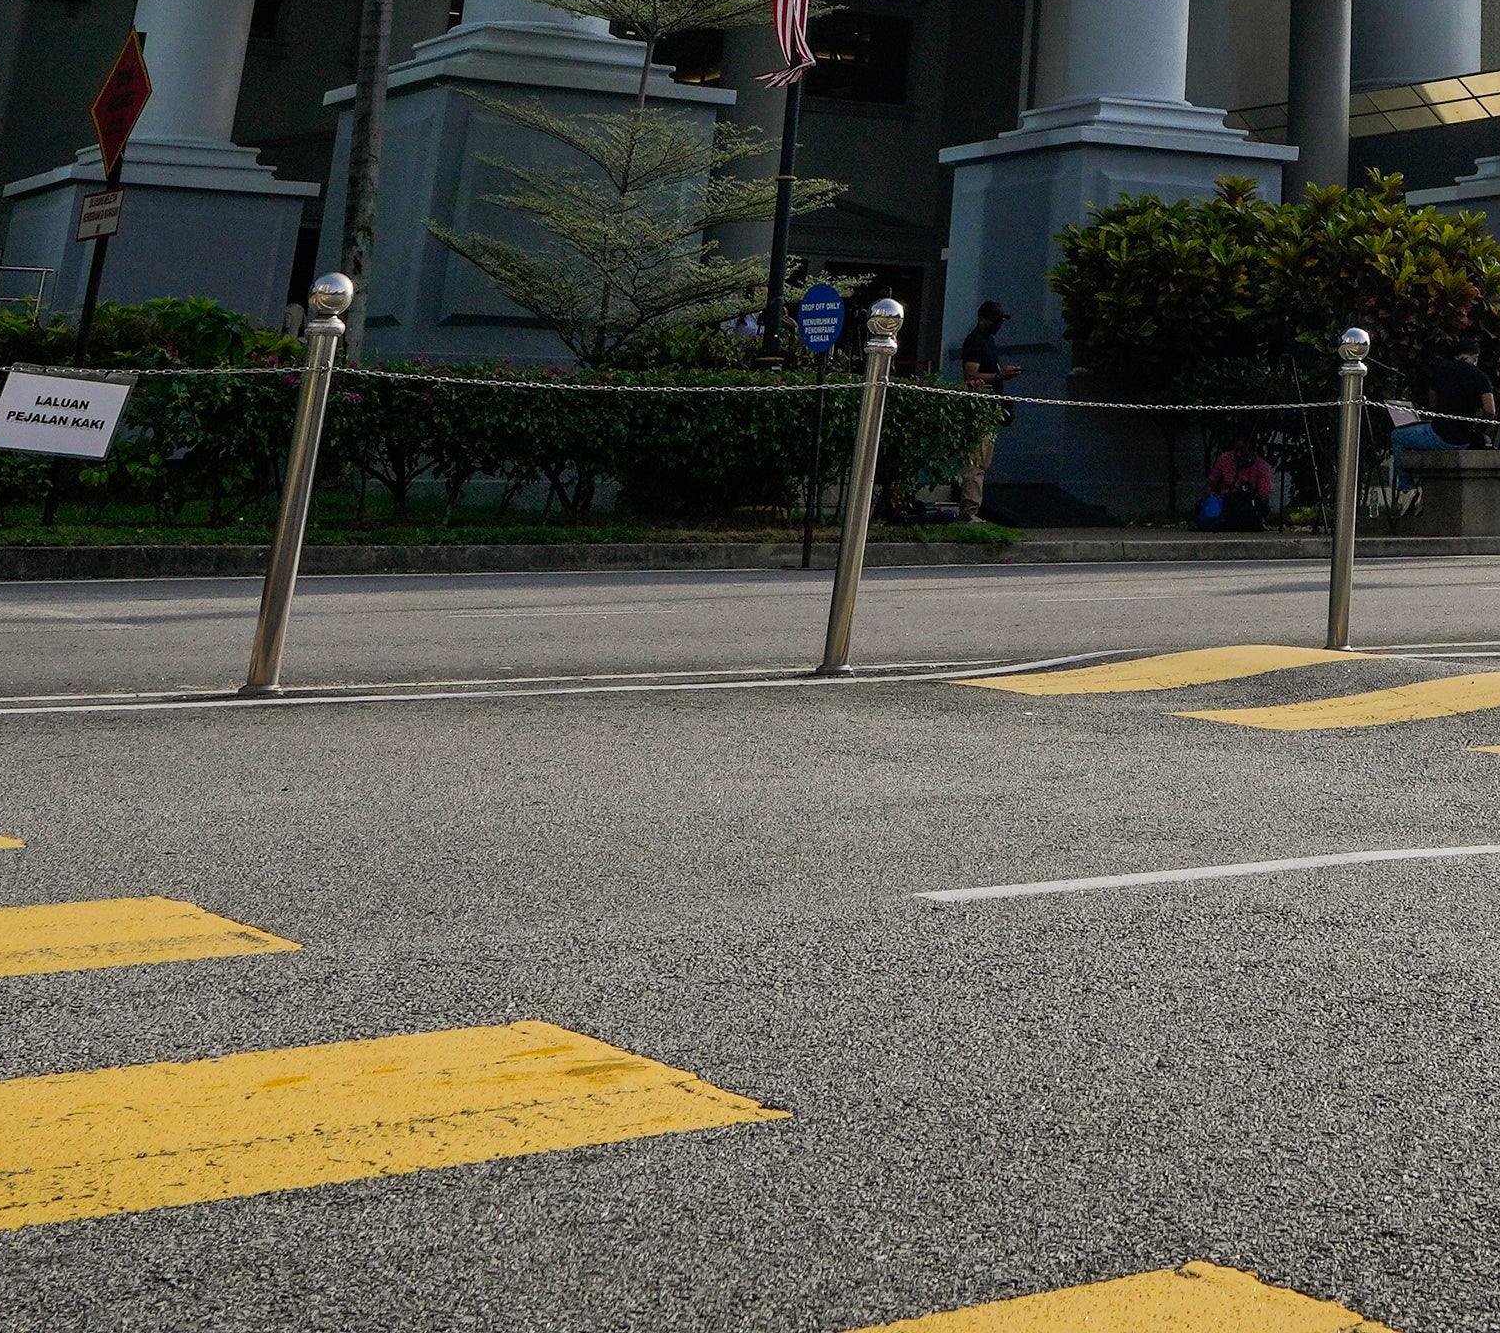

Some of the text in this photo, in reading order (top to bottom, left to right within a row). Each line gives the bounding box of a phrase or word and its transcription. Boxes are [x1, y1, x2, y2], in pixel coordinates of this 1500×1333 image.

[35, 395, 90, 411] LALUAN
[6, 410, 105, 431] PEJALAN KAKI
